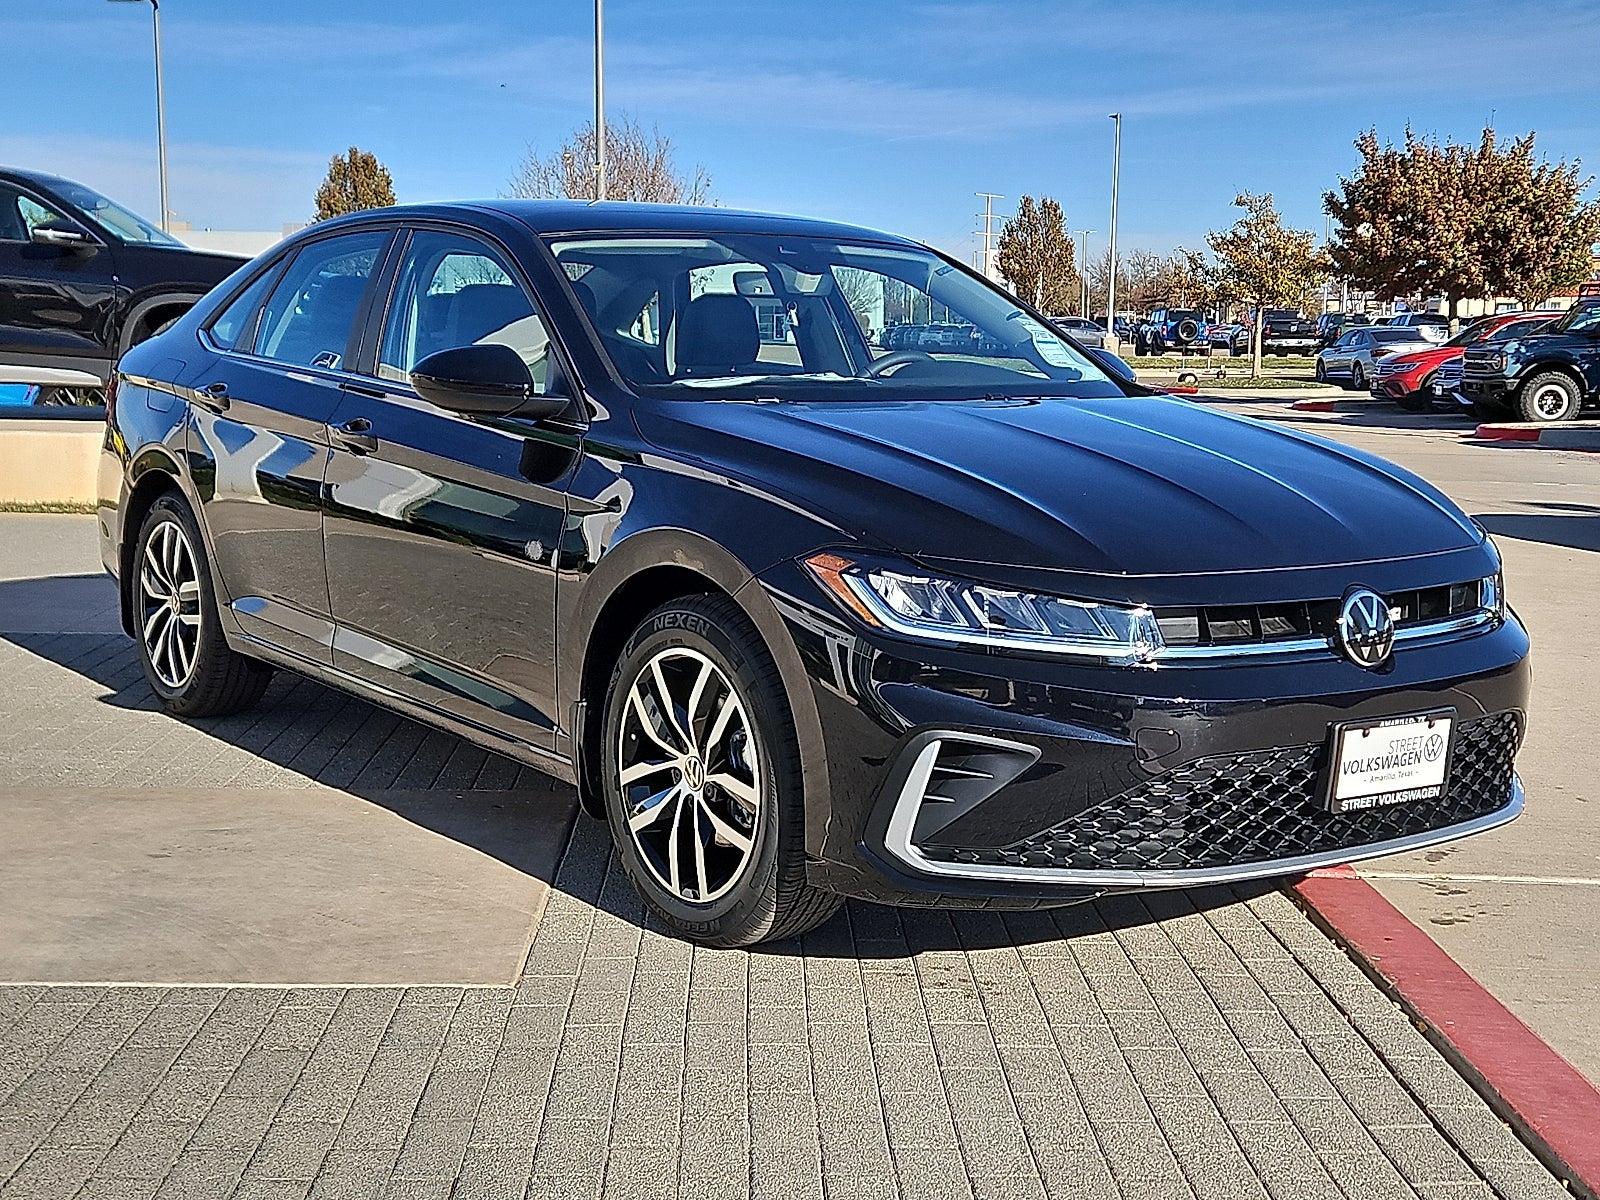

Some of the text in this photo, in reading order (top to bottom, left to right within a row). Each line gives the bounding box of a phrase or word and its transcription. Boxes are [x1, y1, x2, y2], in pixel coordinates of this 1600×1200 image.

[653, 613, 711, 637] NEXEN
[1389, 736, 1424, 754] STREET
[1343, 750, 1423, 776] VOLKSWAGEN
[1340, 787, 1440, 812] STREET VOLKSWAGEN
